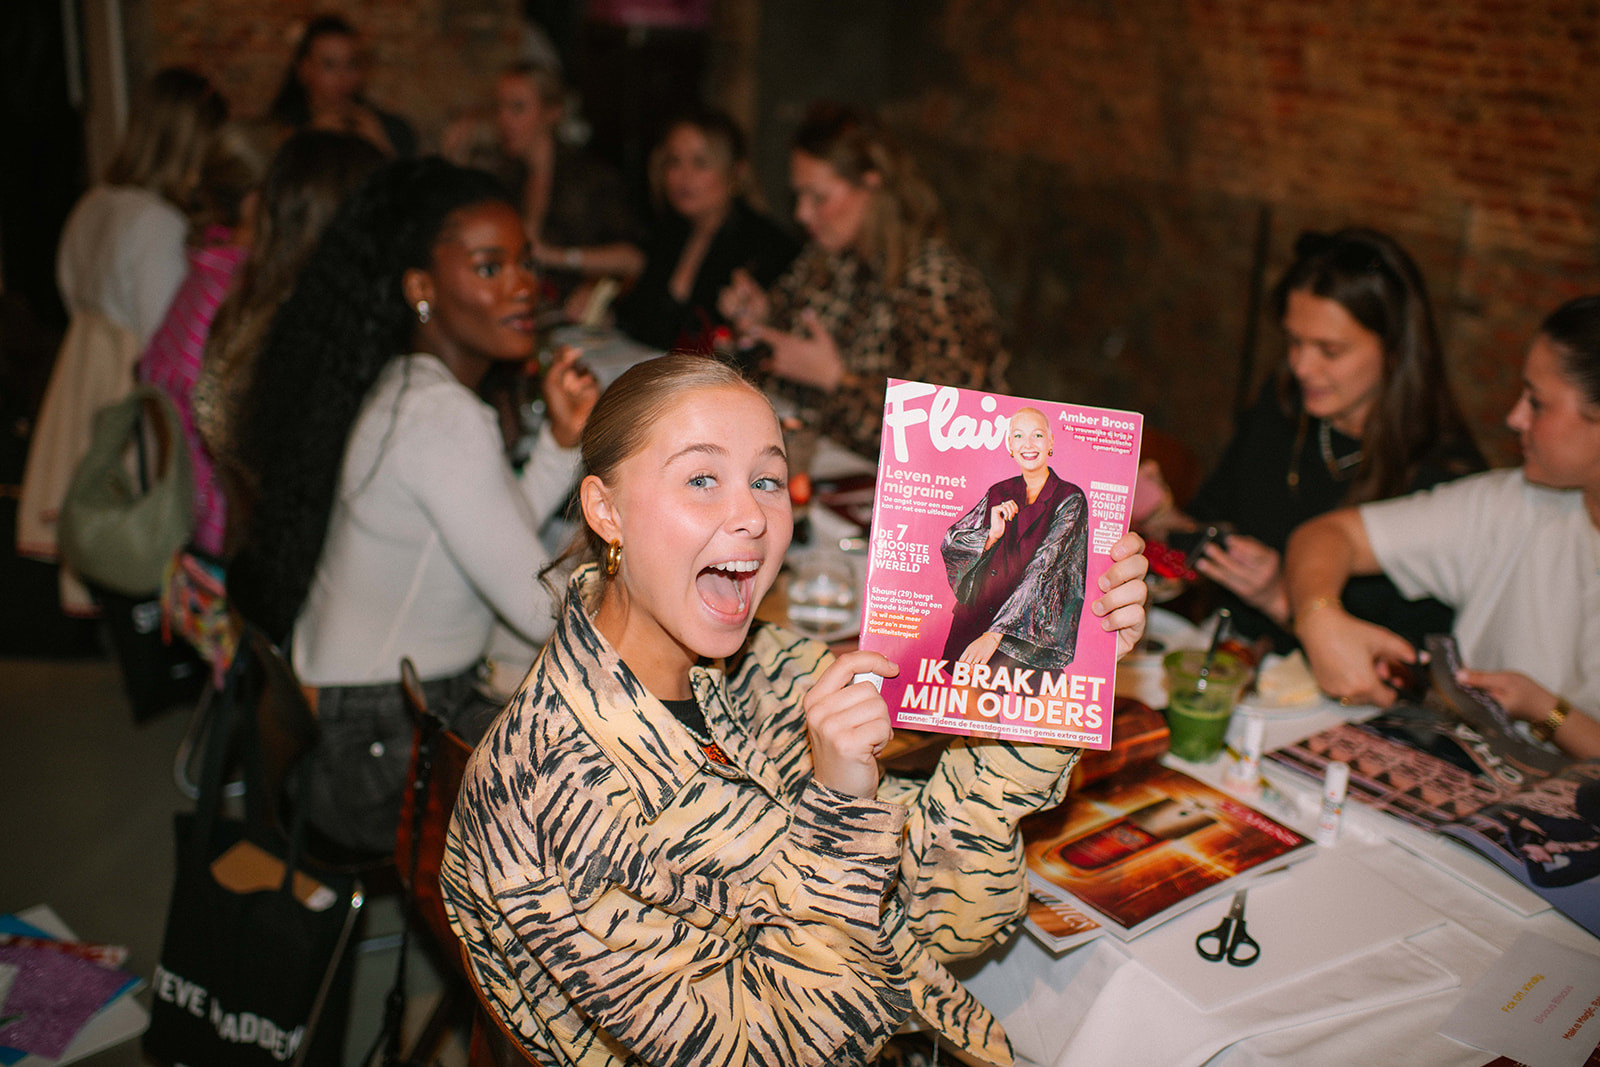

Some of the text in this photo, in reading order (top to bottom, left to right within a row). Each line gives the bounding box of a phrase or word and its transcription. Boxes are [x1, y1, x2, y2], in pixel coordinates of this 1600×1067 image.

[1059, 410, 1135, 430] Amber Broos
[886, 465, 967, 488] Leven met
[884, 480, 954, 500] migraine
[1089, 491, 1127, 504] FACELIFT
[913, 499, 927, 507] voor
[941, 503, 964, 512] aanval
[1092, 500, 1126, 512] ZONDER
[1092, 509, 1124, 521] SNIJDEN
[880, 524, 908, 540] DE 7
[876, 539, 929, 554] MOOISTE
[876, 549, 930, 565] SPA'S TER
[875, 558, 920, 573] WERELD
[871, 594, 888, 602] haar
[890, 597, 913, 605] droom
[872, 586, 934, 601] Shauni (29) bergt
[870, 602, 897, 610] tweede
[898, 605, 920, 615] kindje
[917, 658, 1106, 702] IK BRAK MET
[900, 684, 1103, 729] MIJN OUDERS
[898, 714, 928, 722] Lisanne:
[969, 722, 1011, 734] feestdagen
[1020, 727, 1032, 735] het
[1033, 730, 1055, 738] gemis
[1057, 732, 1077, 740] extra
